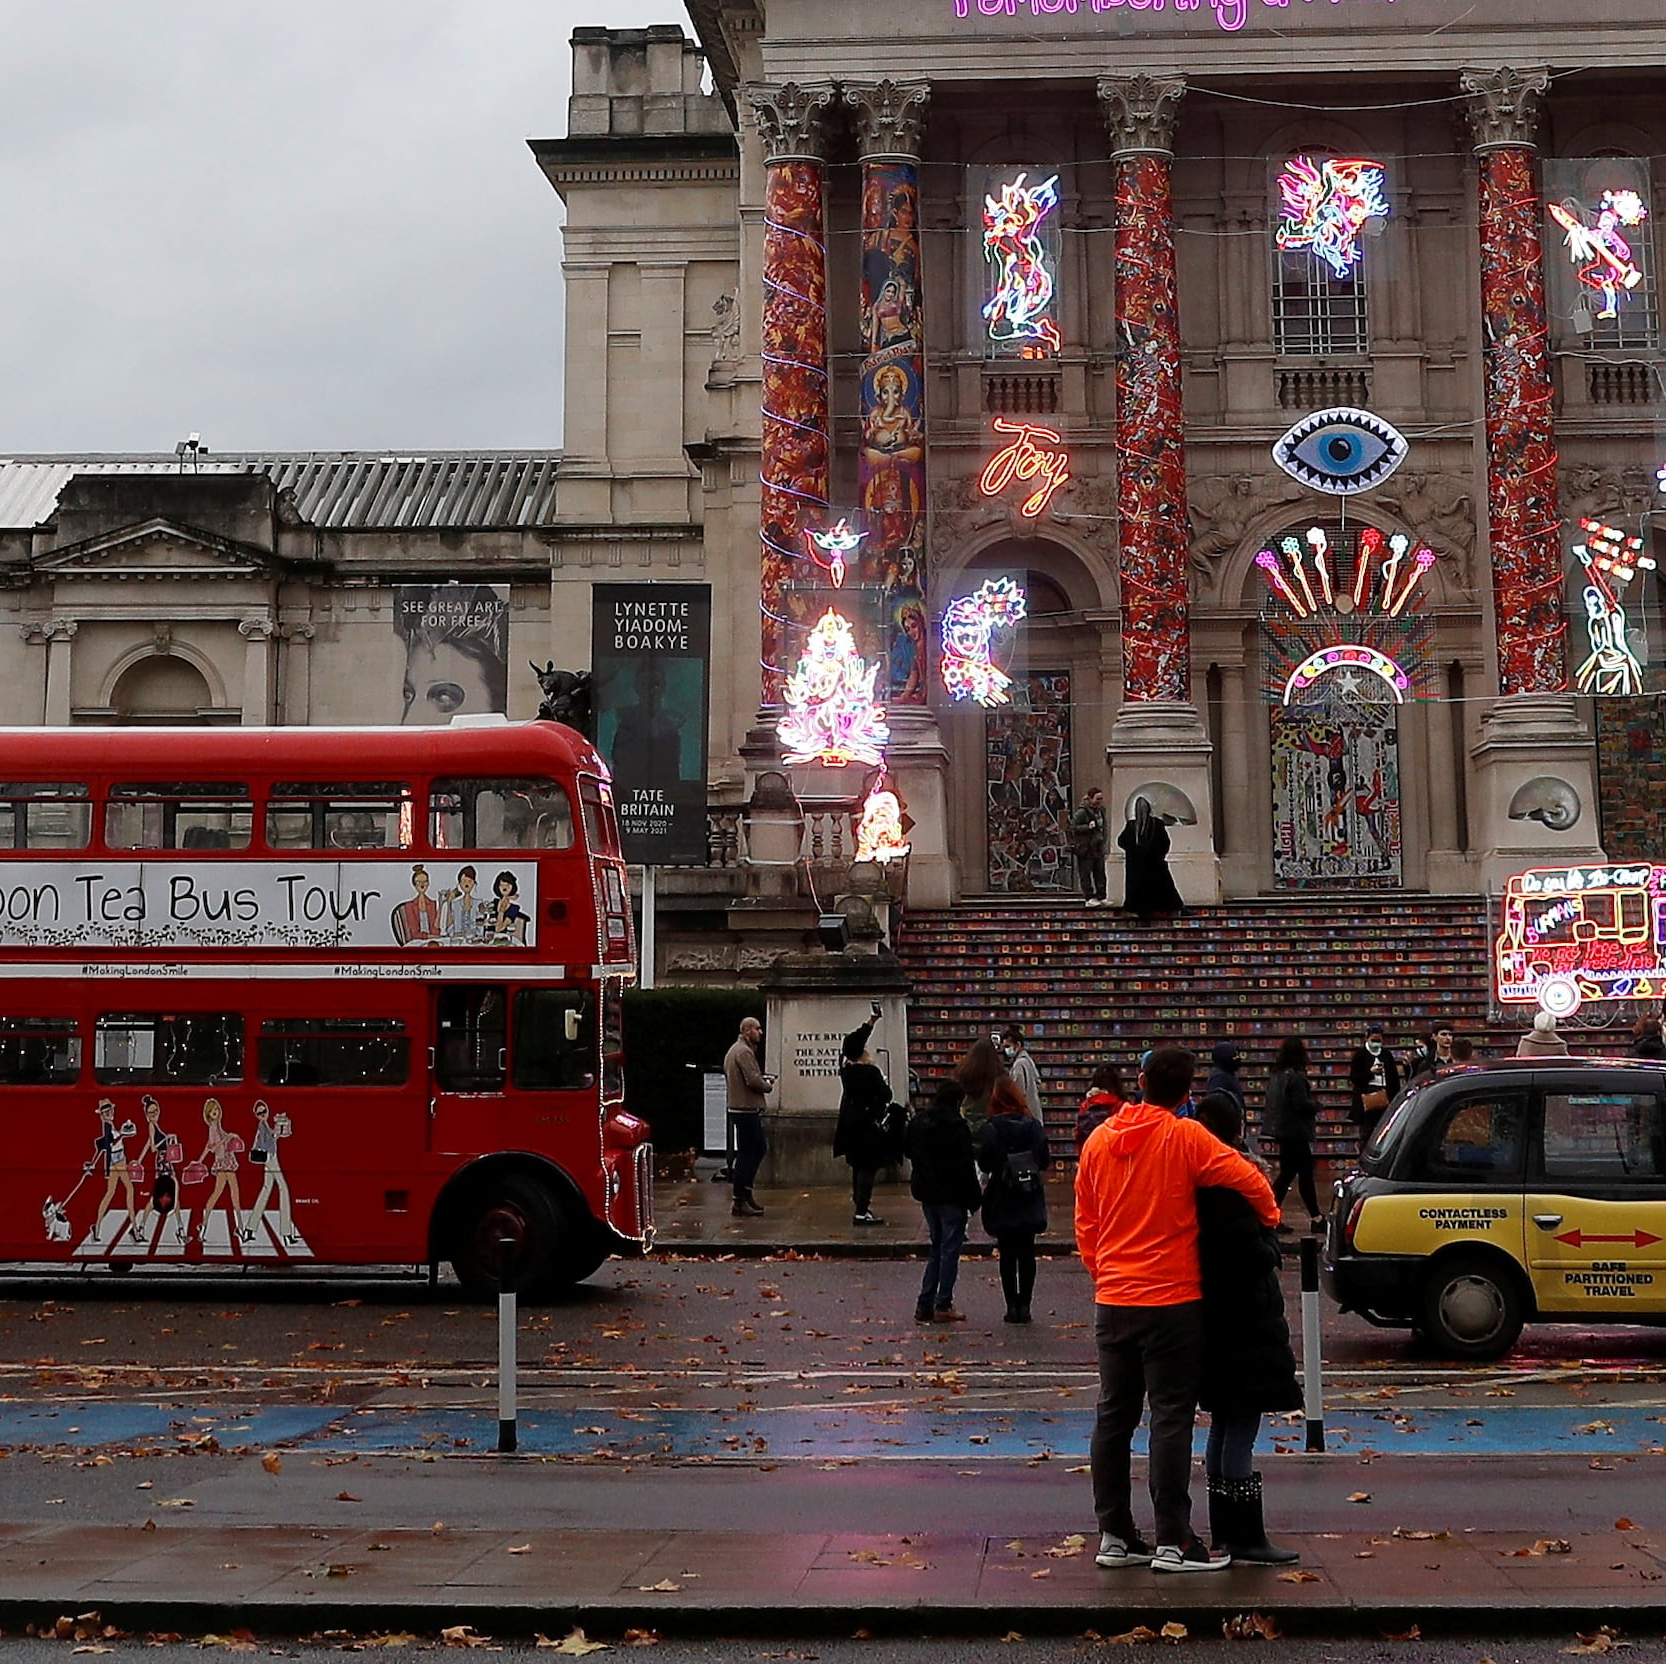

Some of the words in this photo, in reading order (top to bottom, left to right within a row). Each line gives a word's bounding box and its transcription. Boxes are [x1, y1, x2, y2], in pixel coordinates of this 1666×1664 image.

[980, 417, 1070, 518] Joy
[402, 601, 424, 613] SEE
[428, 601, 471, 613] GREAT
[614, 602, 689, 616] LYNETTE
[421, 615, 447, 627] FOR
[451, 615, 481, 627] FREE
[614, 619, 689, 633] YIADOM-
[614, 635, 688, 649] BOAKYE
[632, 789, 664, 802] TATE
[621, 804, 674, 816] BRITAIN
[75, 874, 146, 921] Tea
[169, 875, 260, 921] Bus
[276, 874, 382, 921] Tour
[82, 964, 188, 978] #MakingLondonSmile
[334, 965, 443, 978] #MakingLondonSmile
[797, 1033, 820, 1041] TATE
[1419, 1209, 1508, 1218] CONTACTLESS
[1435, 1220, 1492, 1229] PAYMENT
[1592, 1262, 1626, 1272] SAFE
[1565, 1273, 1654, 1284] PARTITIONED
[1583, 1285, 1635, 1297] TRAVEL
